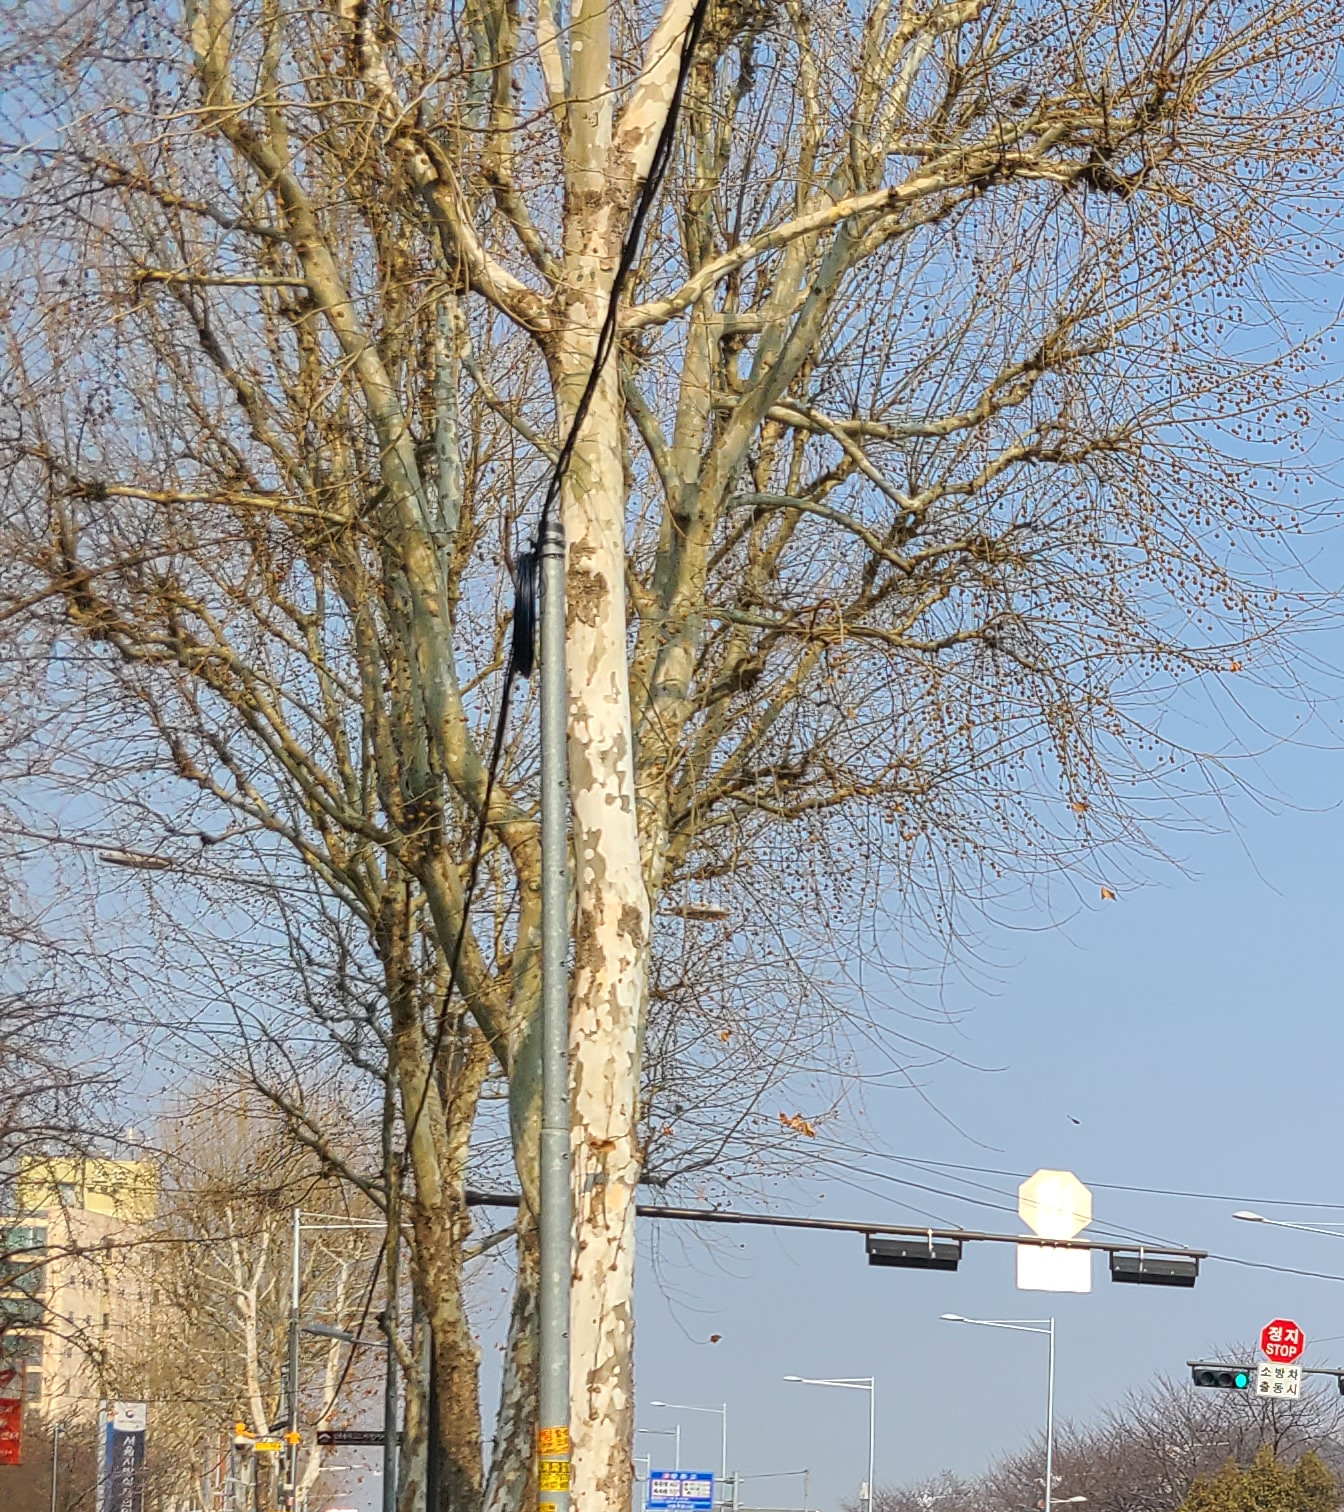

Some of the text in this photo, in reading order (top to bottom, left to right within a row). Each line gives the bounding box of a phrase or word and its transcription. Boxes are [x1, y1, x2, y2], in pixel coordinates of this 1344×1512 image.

[1268, 1326, 1299, 1344] 정지
[1265, 1343, 1297, 1357] STOP
[1260, 1367, 1298, 1380] 소방차
[1259, 1381, 1297, 1395] 출동시
